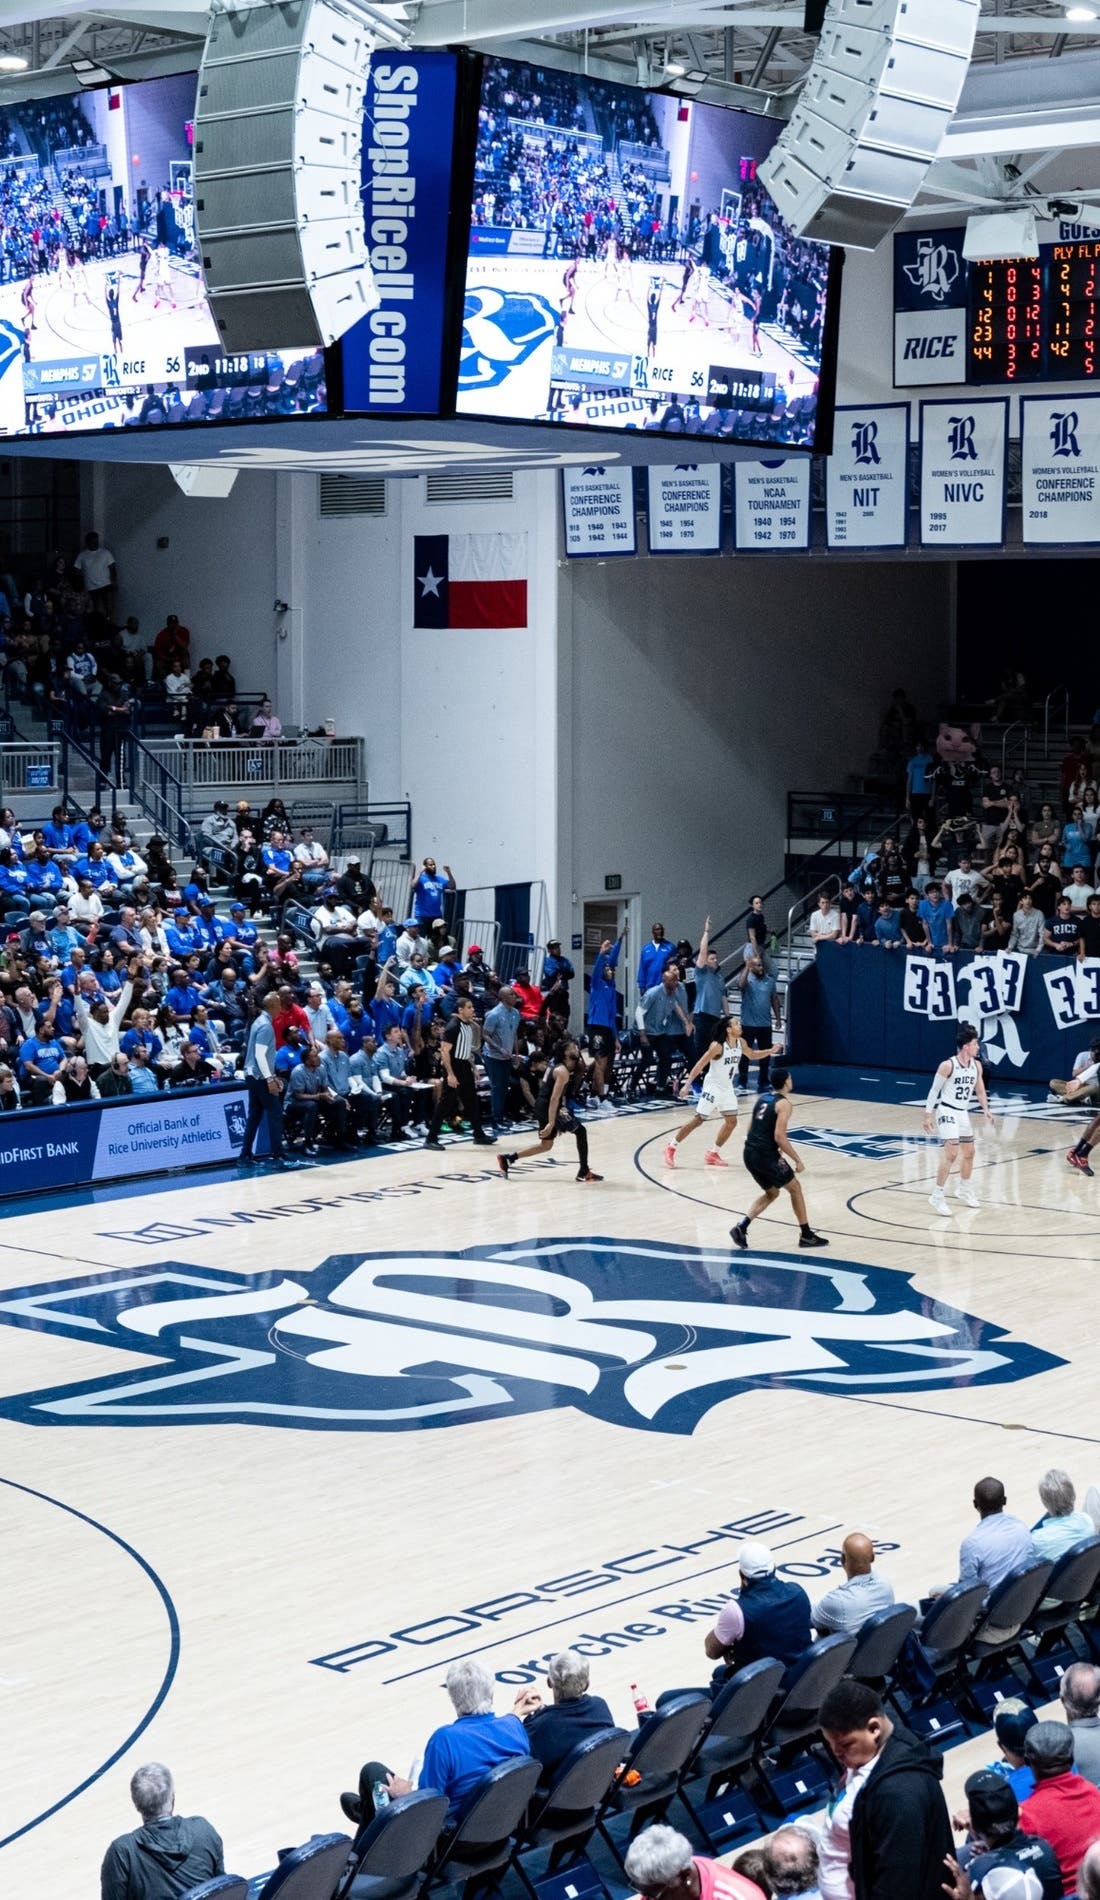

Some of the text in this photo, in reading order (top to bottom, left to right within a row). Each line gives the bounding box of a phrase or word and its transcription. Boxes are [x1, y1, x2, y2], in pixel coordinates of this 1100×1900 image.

[1054, 245, 1073, 260] PLY
[1079, 244, 1092, 258] FL
[988, 263, 1095, 284] 1 0 4 2 1
[984, 281, 1094, 302] 4 0 3 4 2
[979, 302, 1095, 323] 12 0 12 7 1
[973, 320, 1094, 342] 23 0 11 11 2
[903, 335, 957, 360] RICE
[973, 340, 1094, 359] 44 3 2 42 4
[123, 361, 146, 375] RICE
[165, 356, 180, 373] 56
[188, 357, 265, 376] 2ND 11:18 18
[612, 361, 629, 379] 57
[1007, 358, 1093, 378] 2 5
[40, 363, 97, 384] MEMPHIS 57
[651, 368, 673, 381] RICE
[691, 371, 704, 387] 56
[709, 379, 774, 398] 2ND 11:18 18
[931, 469, 995, 478] WOMEN'S VOLLEYBALL
[1032, 465, 1099, 475] WOMEN'S VOLLEYBALL
[679, 479, 709, 487] BASKETBALL
[748, 476, 798, 485] MEN'S BASKETBALL
[840, 473, 894, 482] MEN'S BASKETBALL
[1036, 478, 1095, 489] CONFERENCE
[585, 483, 621, 492] BASKETBALL
[764, 487, 786, 498] NCAA
[944, 482, 985, 503] NIVC
[570, 494, 622, 506] CONFERENCE
[662, 490, 711, 501] CONFERENCE
[853, 487, 880, 507] NIT
[1038, 490, 1093, 502] CHAMPIONS
[571, 506, 621, 517] CHAMPIONS
[664, 502, 709, 513] CHAMPIONS
[748, 499, 801, 510] TOURNAMENT
[754, 517, 796, 526] 1940 1954
[929, 512, 947, 520] 1995
[1029, 511, 1048, 519] 2018
[929, 524, 947, 532] 2017
[754, 531, 796, 540] 1942 1970
[1053, 924, 1078, 935] RICE
[954, 1076, 975, 1085] RICE
[955, 1087, 970, 1100] 23
[757, 1103, 768, 1119] 2
[127, 1115, 201, 1136] Official Bank of
[108, 1129, 222, 1155] Rice University Athletics
[0, 1148, 43, 1165] IDFIRST
[307, 1510, 806, 1673] PORSCHE
[494, 1623, 667, 1685] orche
[777, 1540, 900, 1577] Oas
